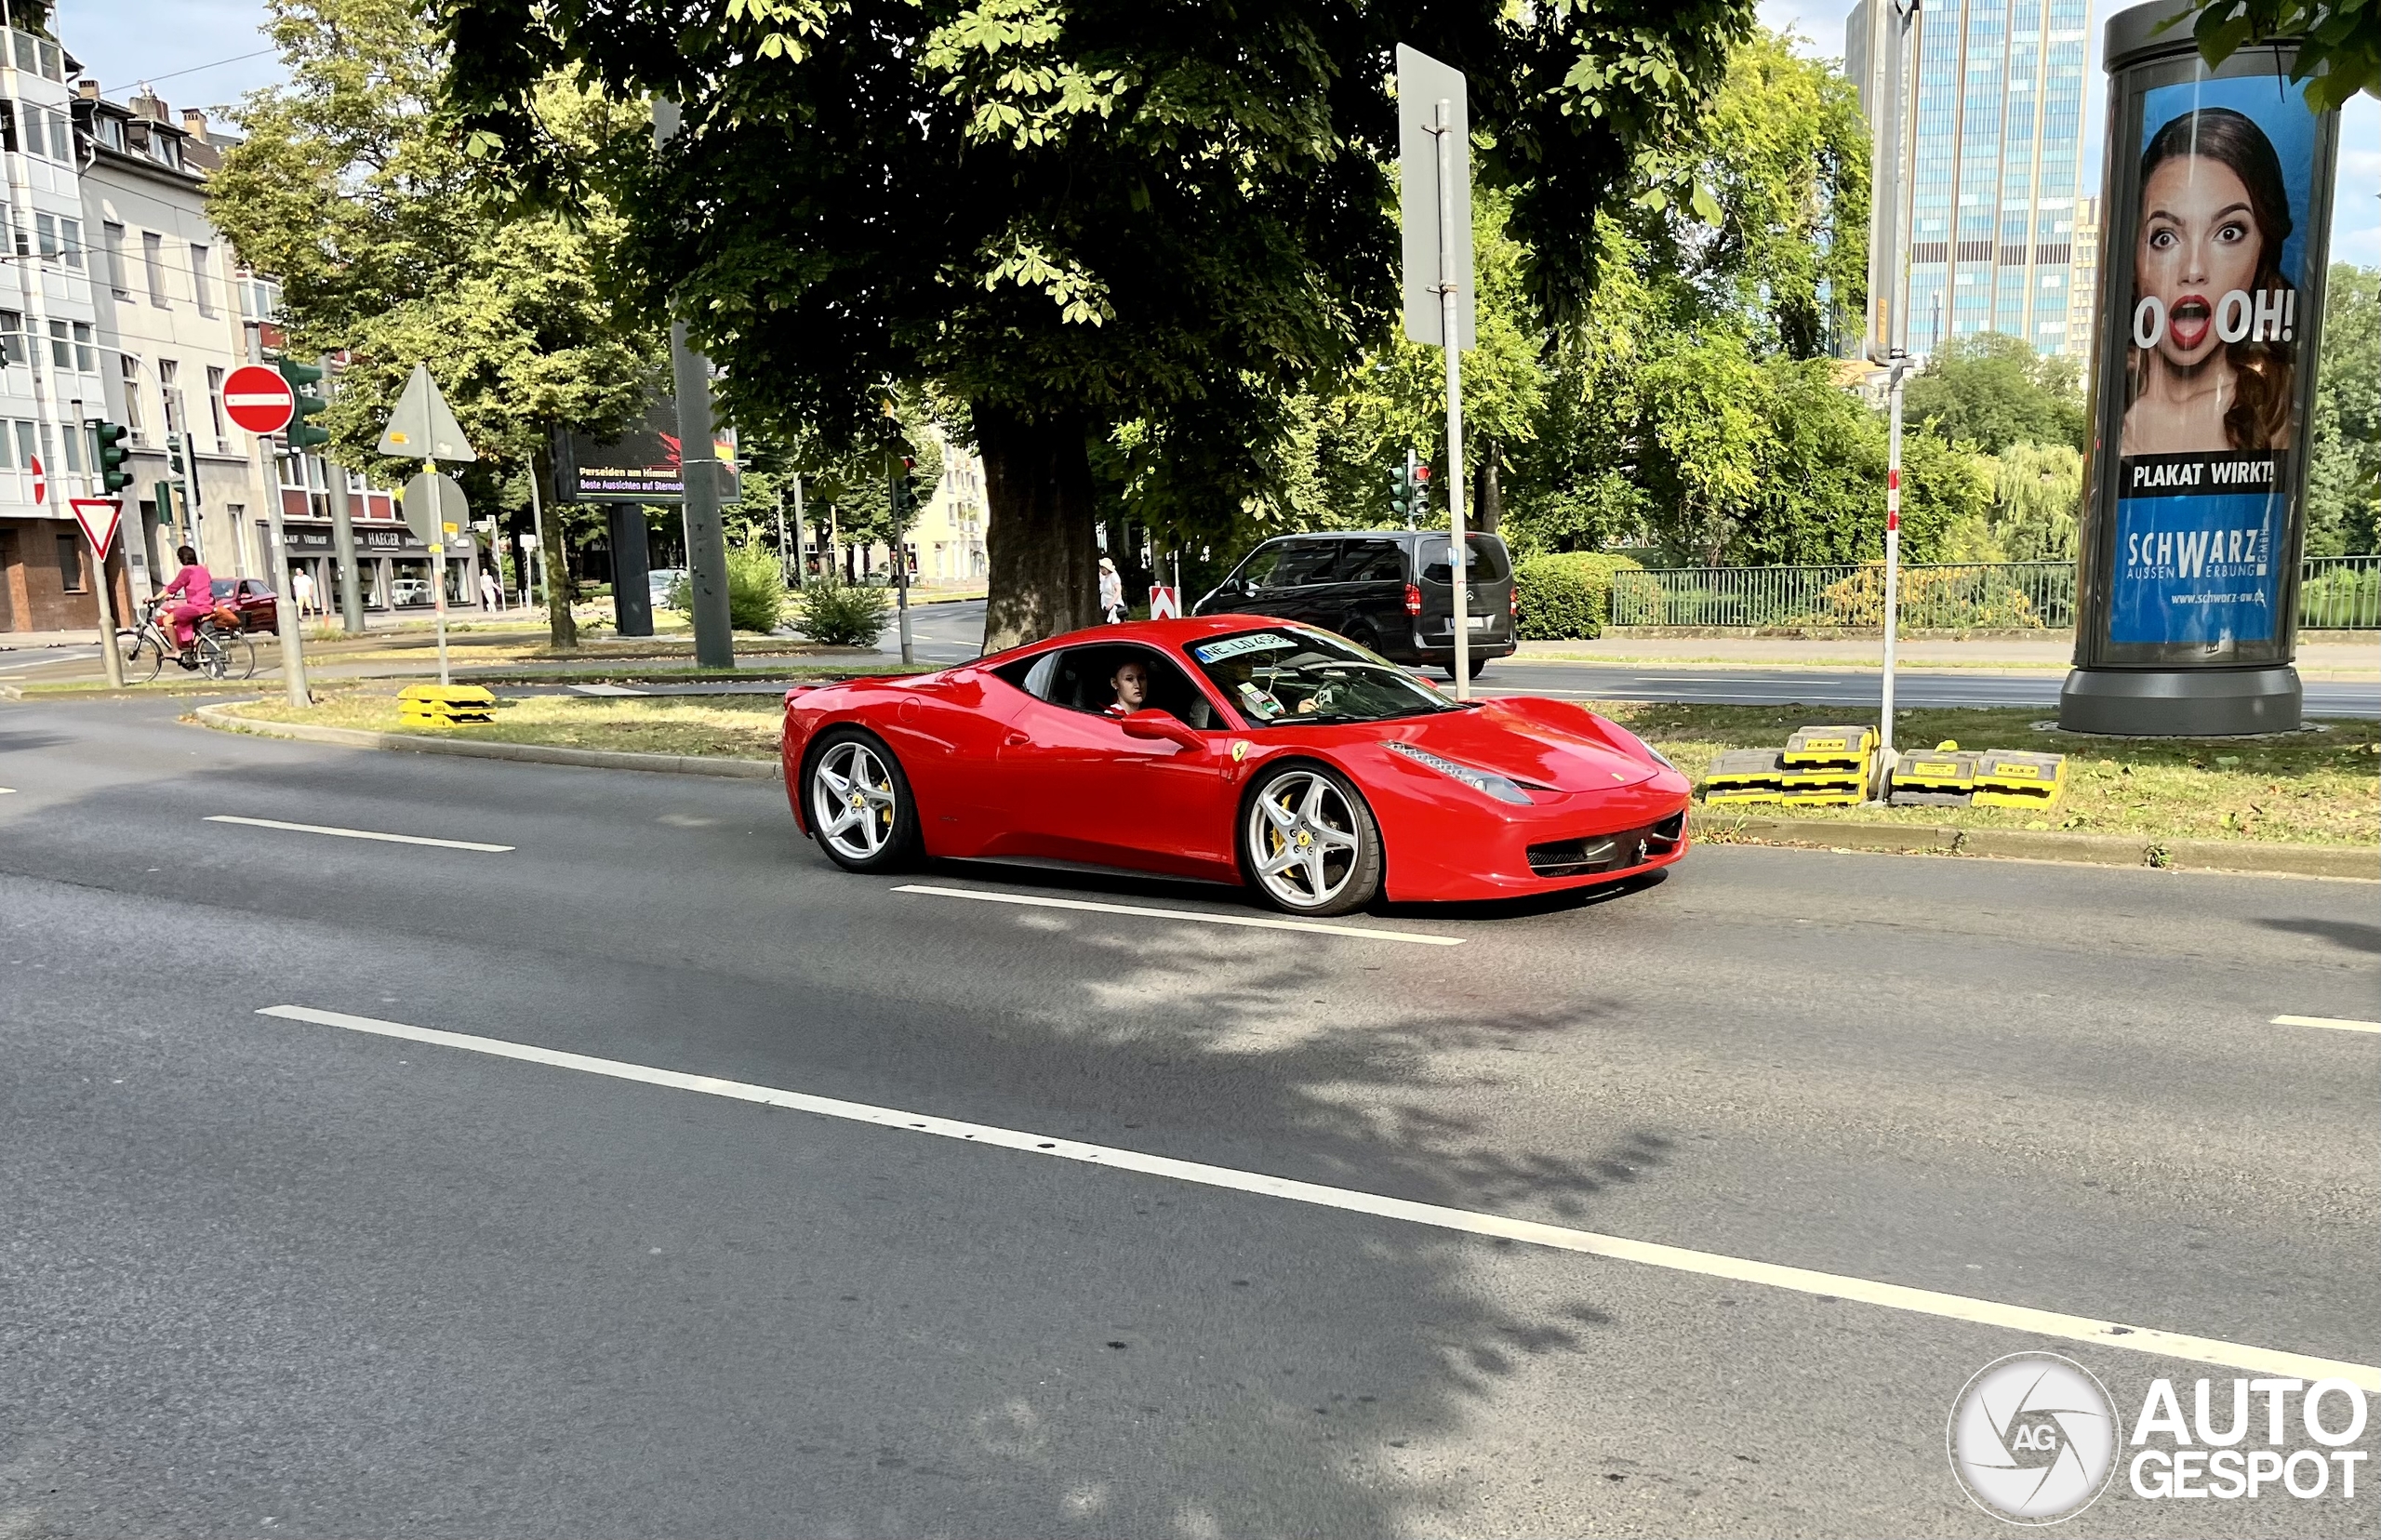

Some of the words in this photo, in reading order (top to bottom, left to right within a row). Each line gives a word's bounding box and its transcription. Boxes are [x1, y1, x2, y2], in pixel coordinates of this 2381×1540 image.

[2134, 296, 2165, 349] O
[2215, 289, 2295, 343] OH!
[579, 467, 626, 477] Perseiden
[627, 469, 642, 477] am
[643, 467, 677, 478] Himmel
[2134, 463, 2204, 487] PLAKAT
[2211, 460, 2275, 485] WIRKT!
[580, 479, 601, 489] Beste
[602, 480, 641, 490] Aussichten
[642, 481, 654, 491] auf
[368, 532, 401, 546] HAEGER
[2127, 529, 2258, 578] SCHWARZ
[2126, 566, 2175, 579] AUSSEN
[1203, 645, 1230, 657] NE
[1230, 640, 1256, 650] LD
